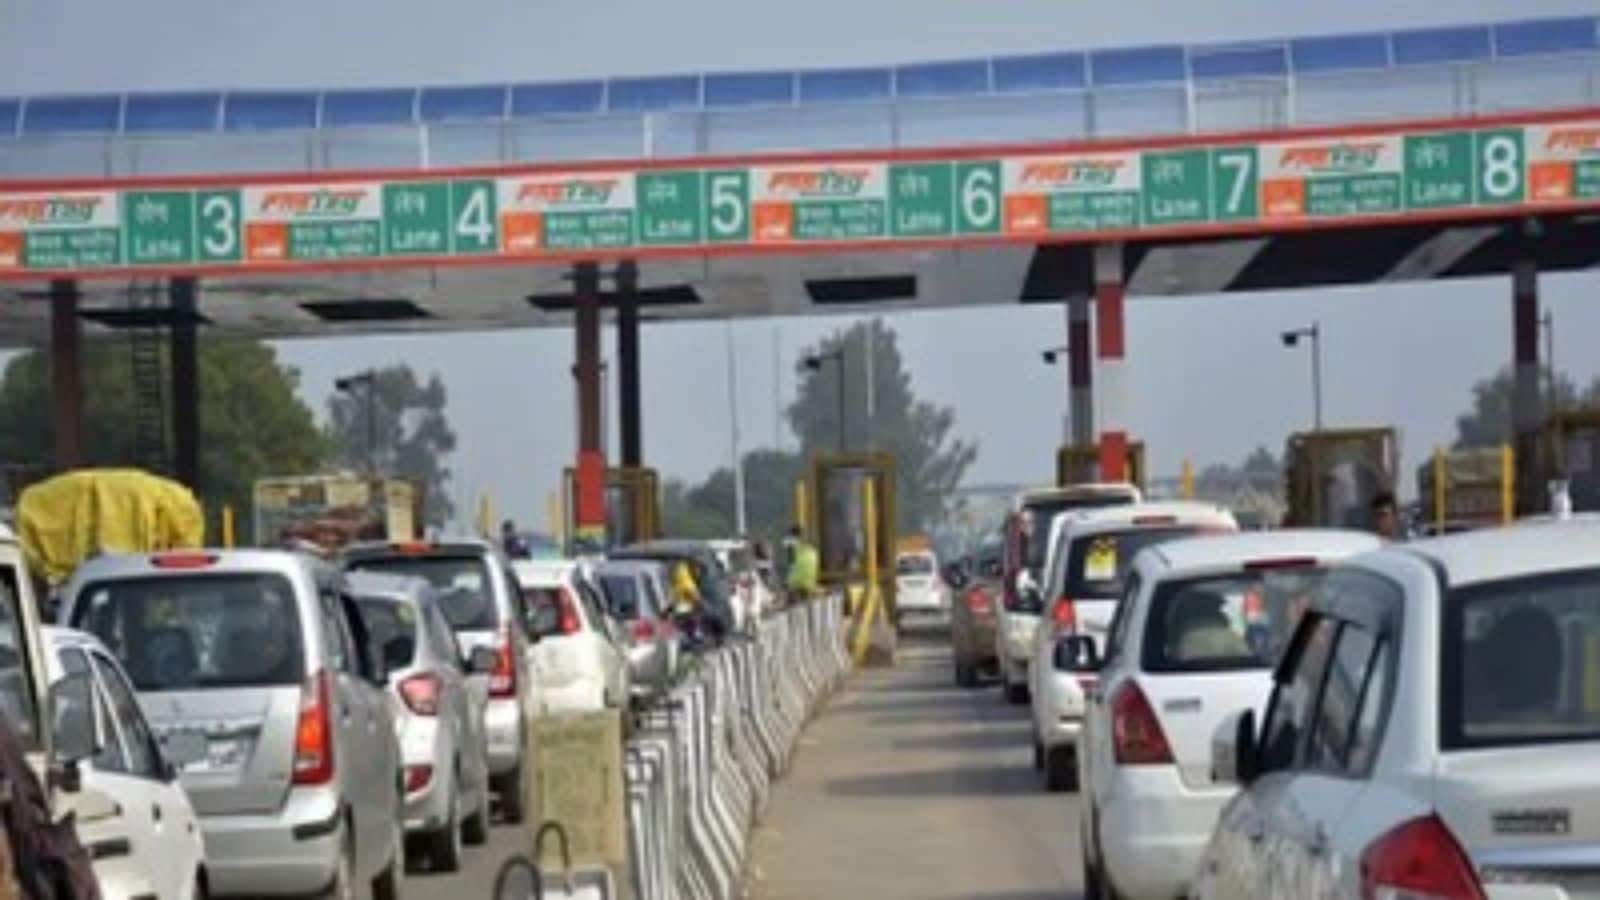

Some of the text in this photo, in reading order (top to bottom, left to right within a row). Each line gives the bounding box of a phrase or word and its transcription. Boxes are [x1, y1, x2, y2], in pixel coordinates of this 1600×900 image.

[1218, 155, 1250, 213] 7
[1483, 137, 1519, 196] 8
[710, 175, 744, 234] 5
[962, 168, 997, 227] 6
[1152, 196, 1198, 217] Lane
[1414, 181, 1463, 203] Lane
[203, 196, 234, 255] 3
[455, 187, 493, 245] 4
[645, 217, 691, 237] Lane
[901, 208, 942, 230] Lane
[135, 235, 182, 257] Lane
[393, 229, 439, 248] Lane
